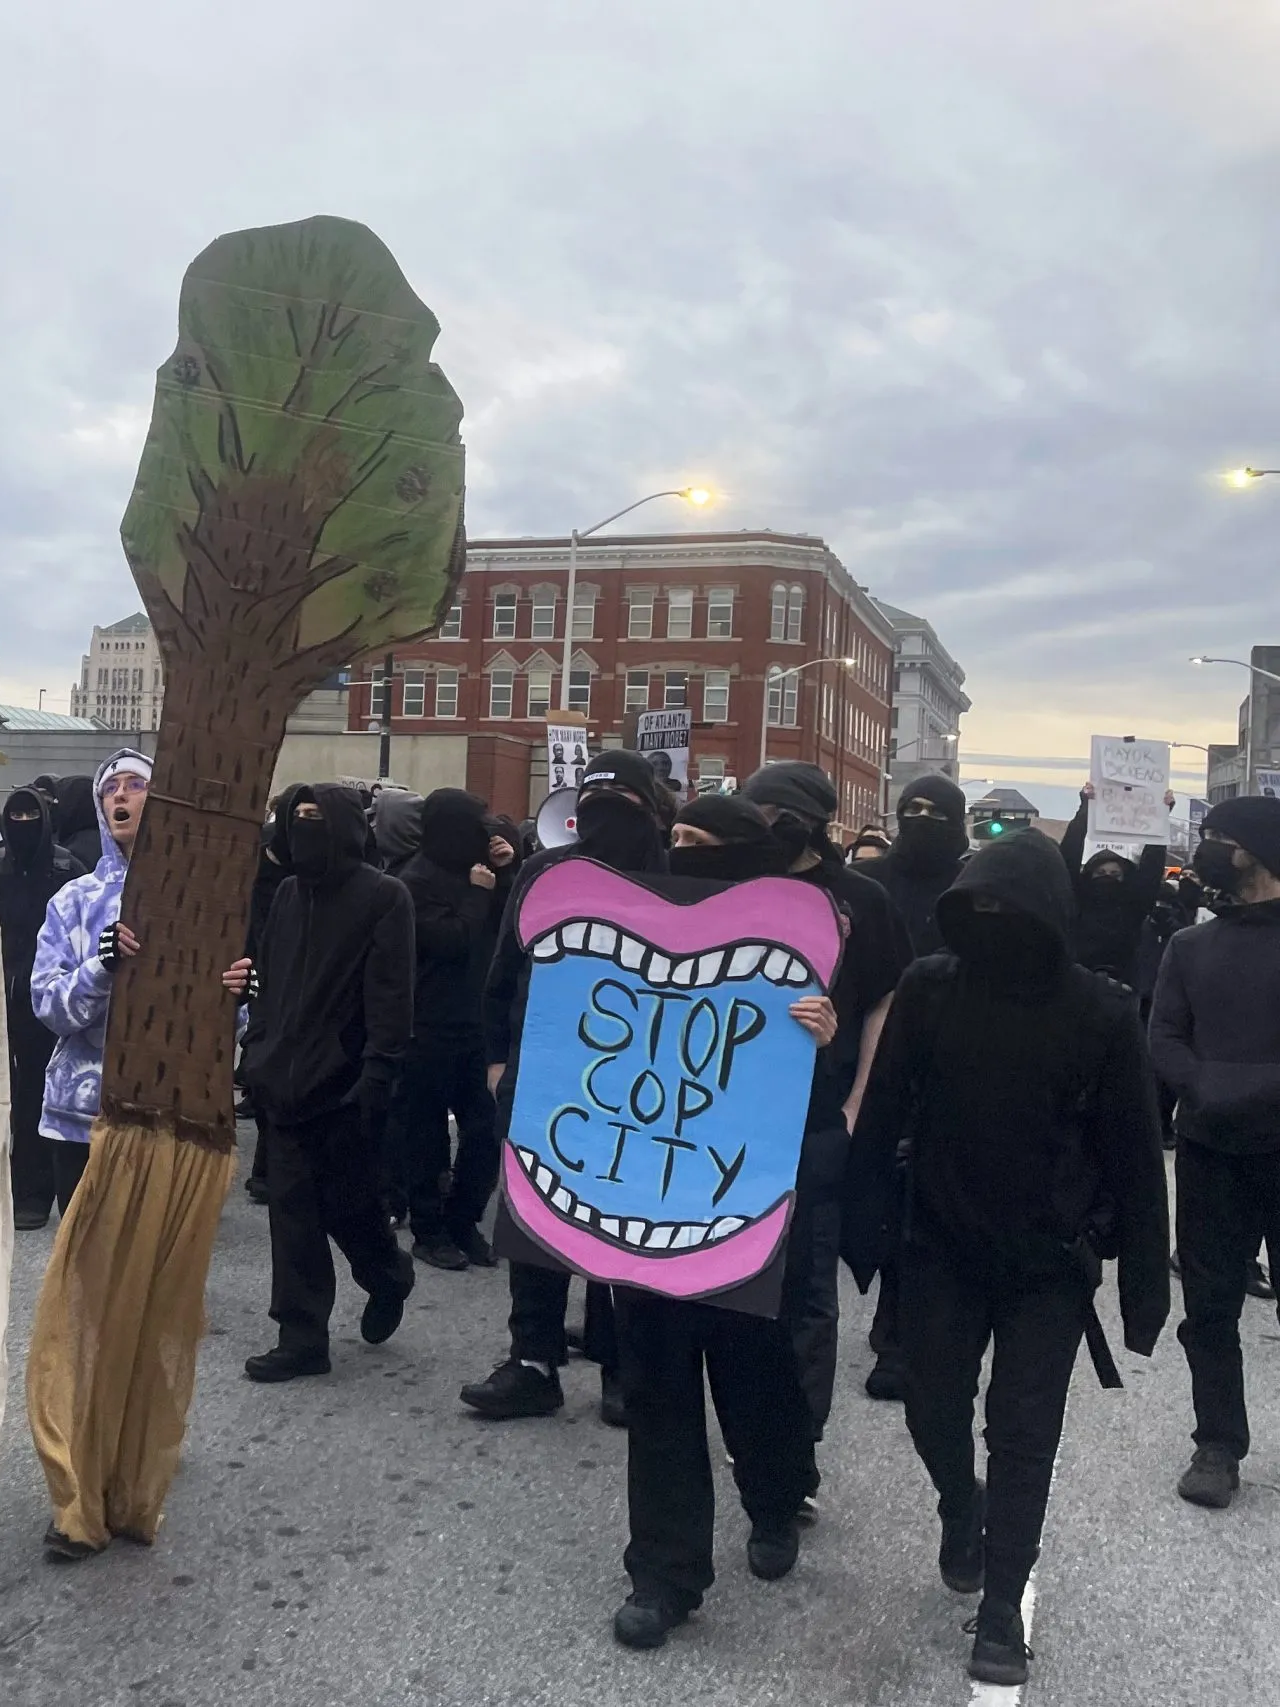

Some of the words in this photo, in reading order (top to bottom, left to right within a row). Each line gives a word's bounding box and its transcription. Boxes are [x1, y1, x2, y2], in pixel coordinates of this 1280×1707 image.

[643, 731, 662, 749] MANY
[663, 730, 687, 748] MORE?
[644, 715, 654, 730] OF
[578, 978, 766, 1091] STOP
[581, 1055, 713, 1138] COP
[546, 1102, 746, 1208] CITY
